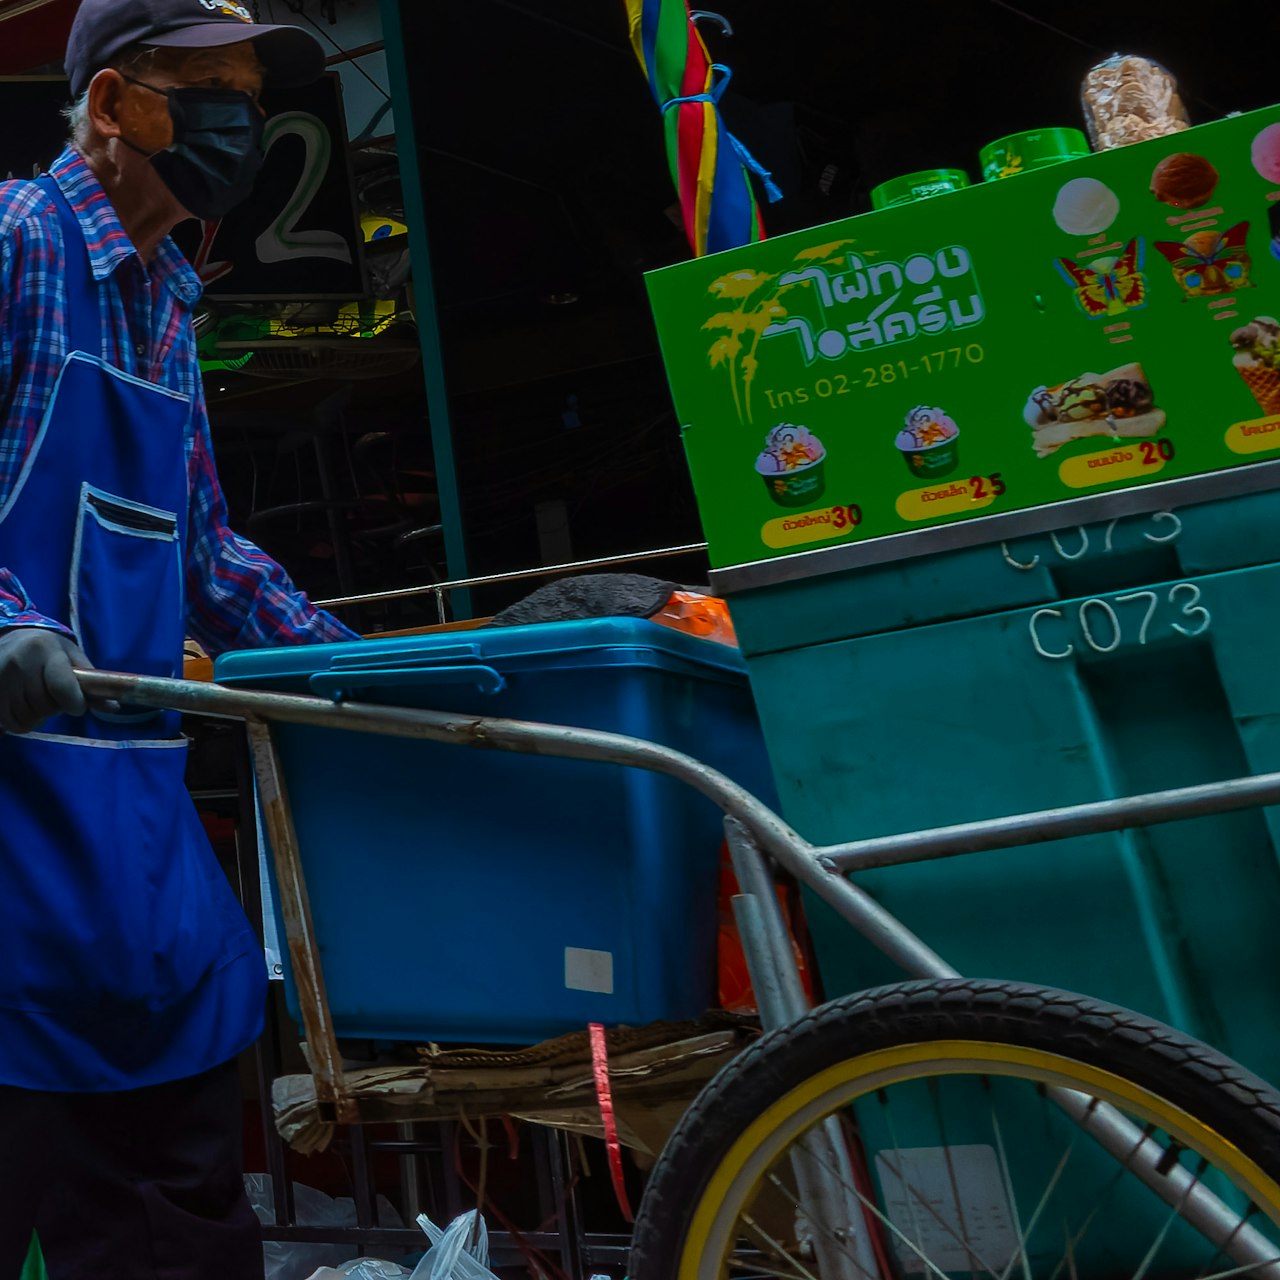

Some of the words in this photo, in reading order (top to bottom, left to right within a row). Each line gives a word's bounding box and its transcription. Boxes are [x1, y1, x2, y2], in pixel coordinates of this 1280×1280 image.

[814, 343, 984, 398] 02-281-1770
[1139, 437, 1175, 466] 20
[969, 472, 1006, 500] 25
[831, 503, 863, 530] 30
[1028, 582, 1211, 660] C073
